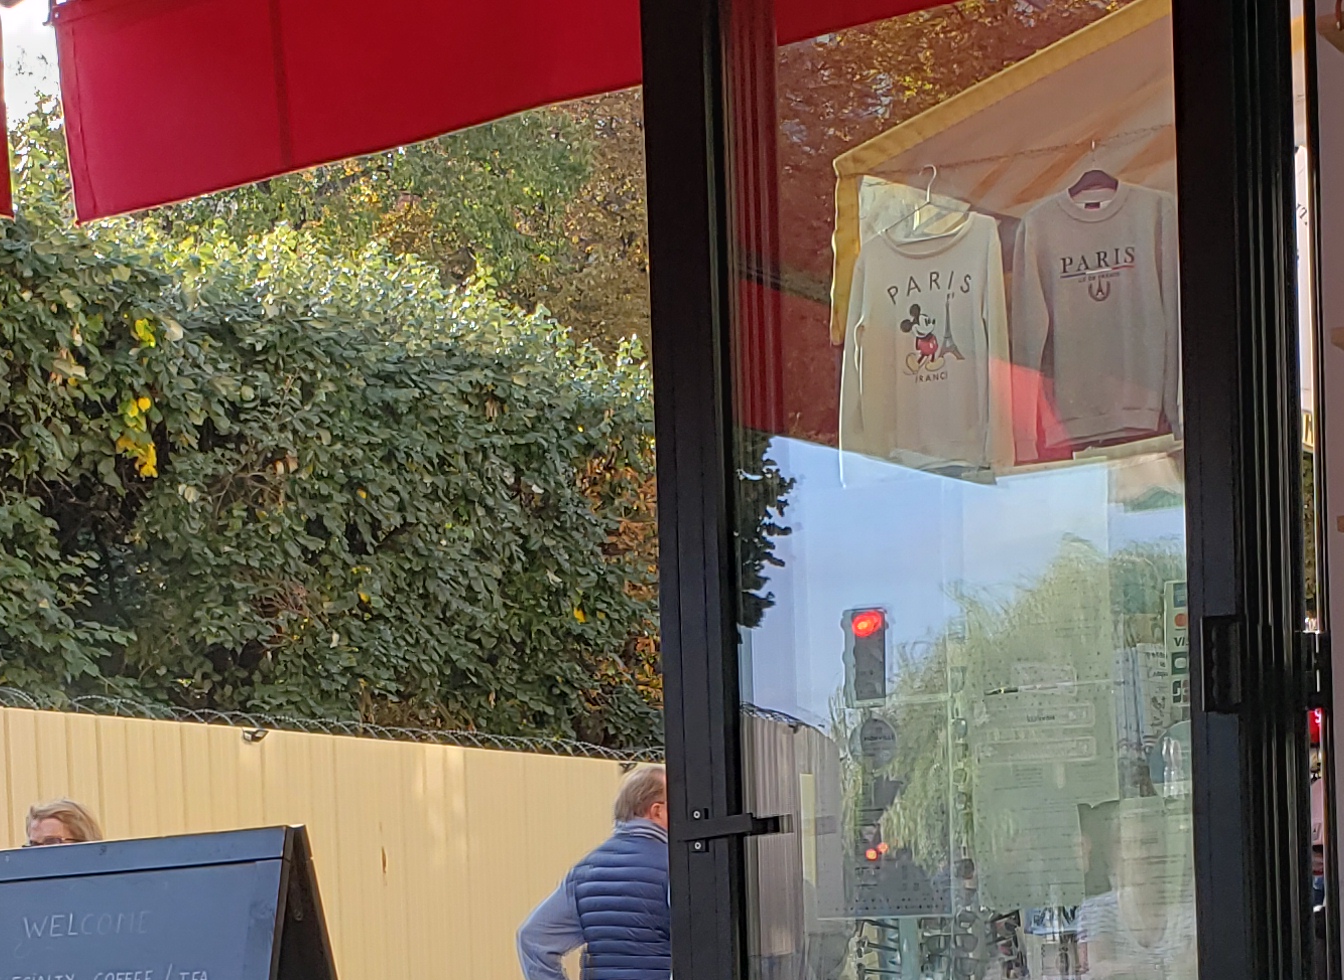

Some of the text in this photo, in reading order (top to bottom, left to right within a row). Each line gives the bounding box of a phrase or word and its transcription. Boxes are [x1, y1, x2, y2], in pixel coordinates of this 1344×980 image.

[1060, 246, 1136, 275] PARIS
[887, 269, 972, 305] PARIS
[23, 908, 154, 939] WELCOME
